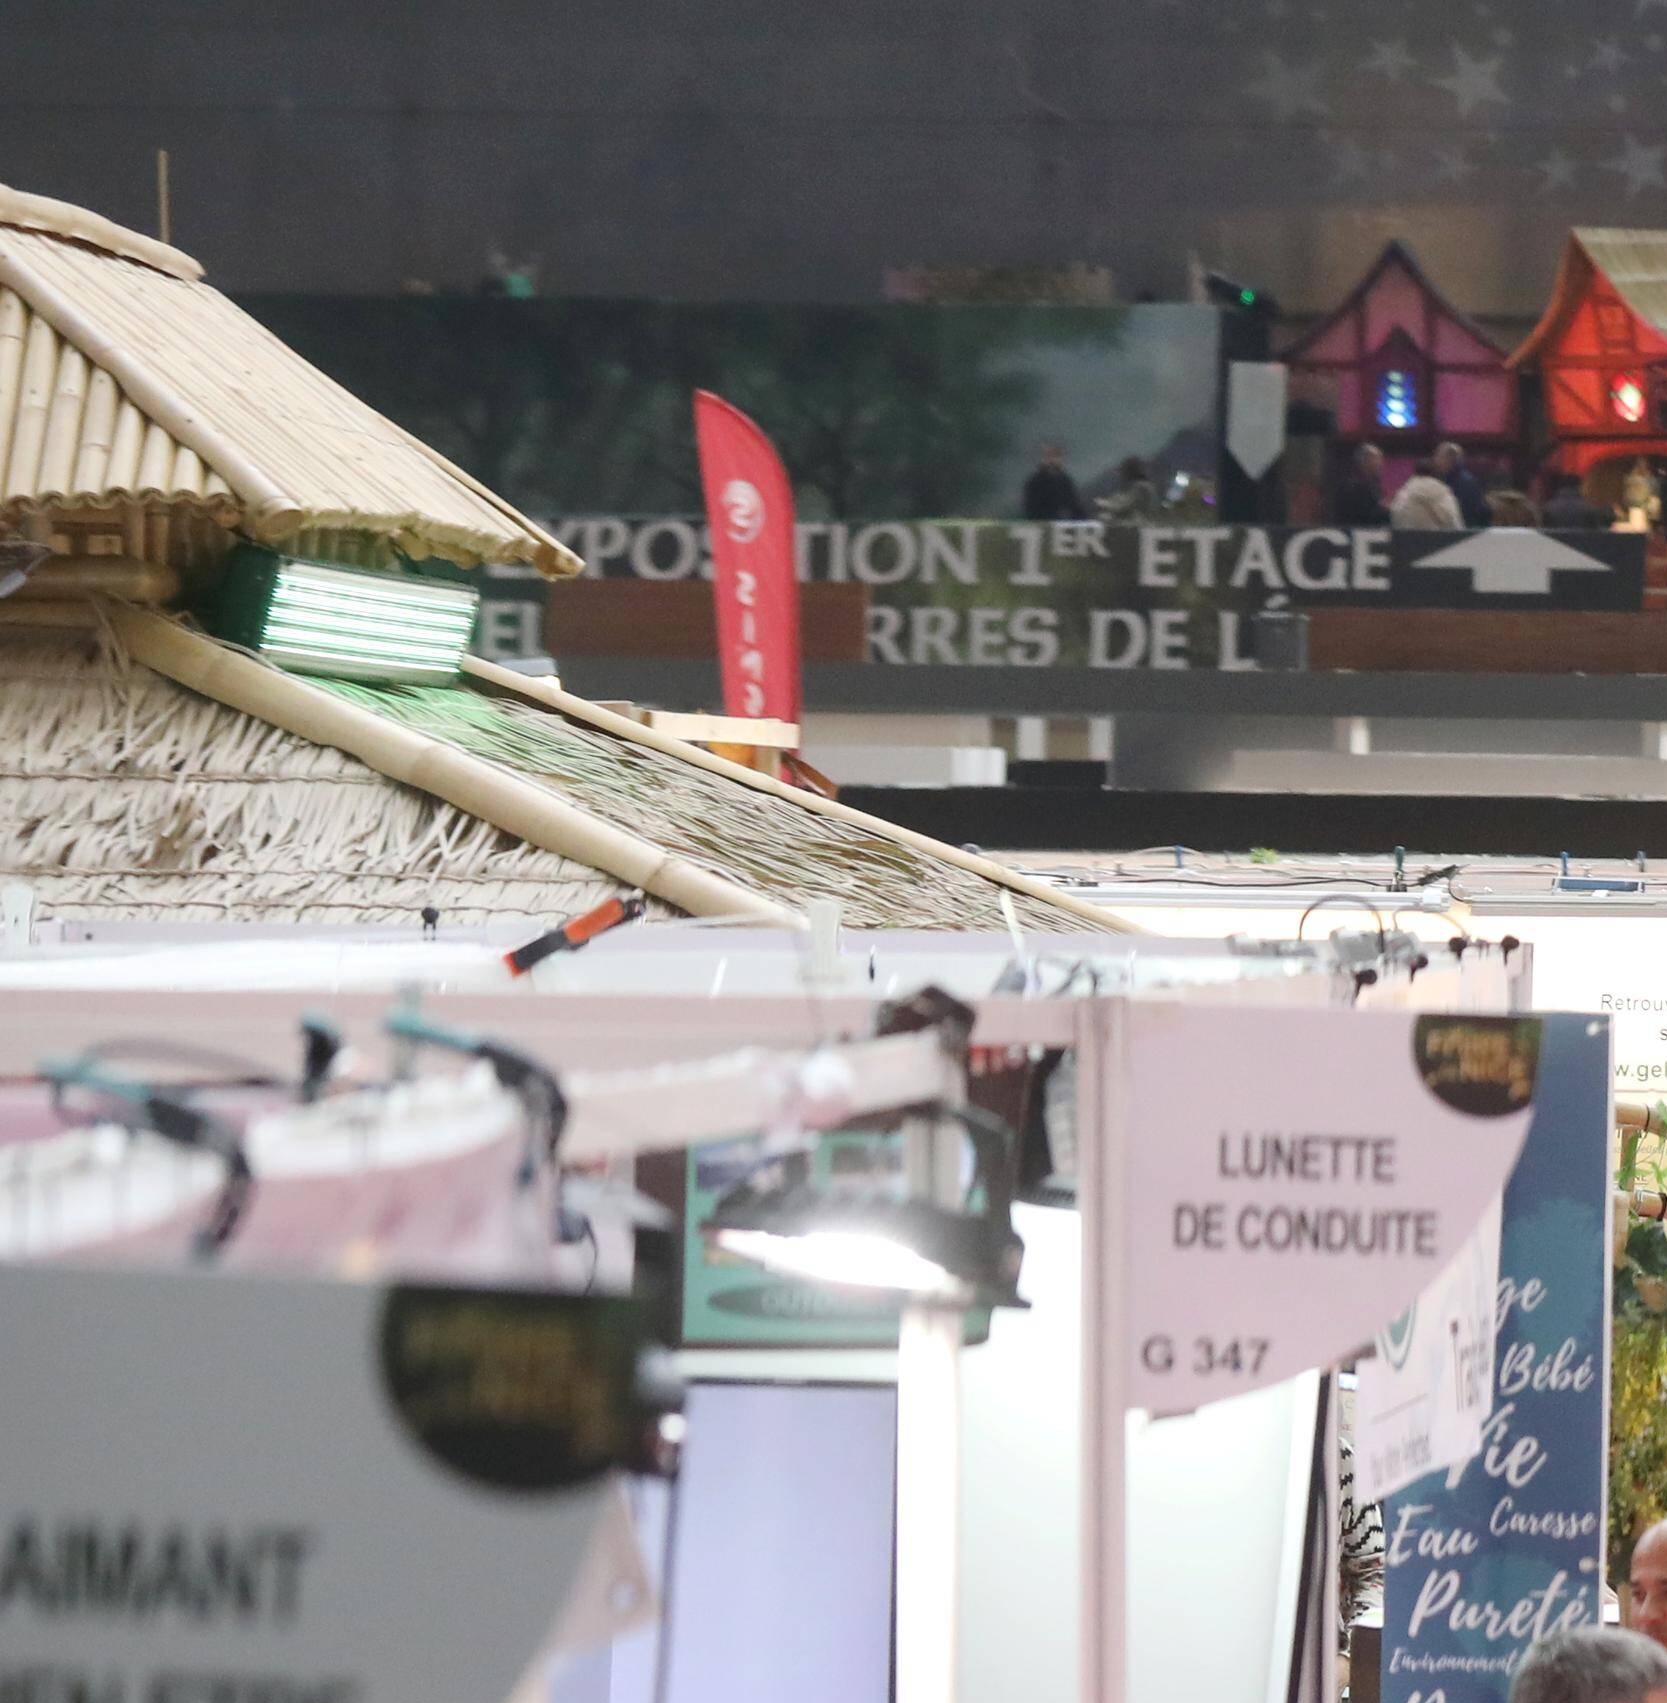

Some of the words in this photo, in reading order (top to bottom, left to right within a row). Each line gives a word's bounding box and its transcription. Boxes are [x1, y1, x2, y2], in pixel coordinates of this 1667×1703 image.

[1137, 526, 1391, 592] ETAGE
[1089, 610, 1190, 670] DE
[1218, 1134, 1397, 1185] LUNETTE
[1173, 1203, 1228, 1250] DE
[1238, 1207, 1437, 1258] CONDUITE
[1143, 1337, 1176, 1374] G
[1193, 1337, 1268, 1376] 347
[1499, 1336, 1594, 1395] Bébé
[1386, 1502, 1478, 1568] Eau
[1488, 1501, 1599, 1541] Caresse
[0, 1517, 313, 1627] AIMANT
[1408, 1568, 1591, 1641] Pureté
